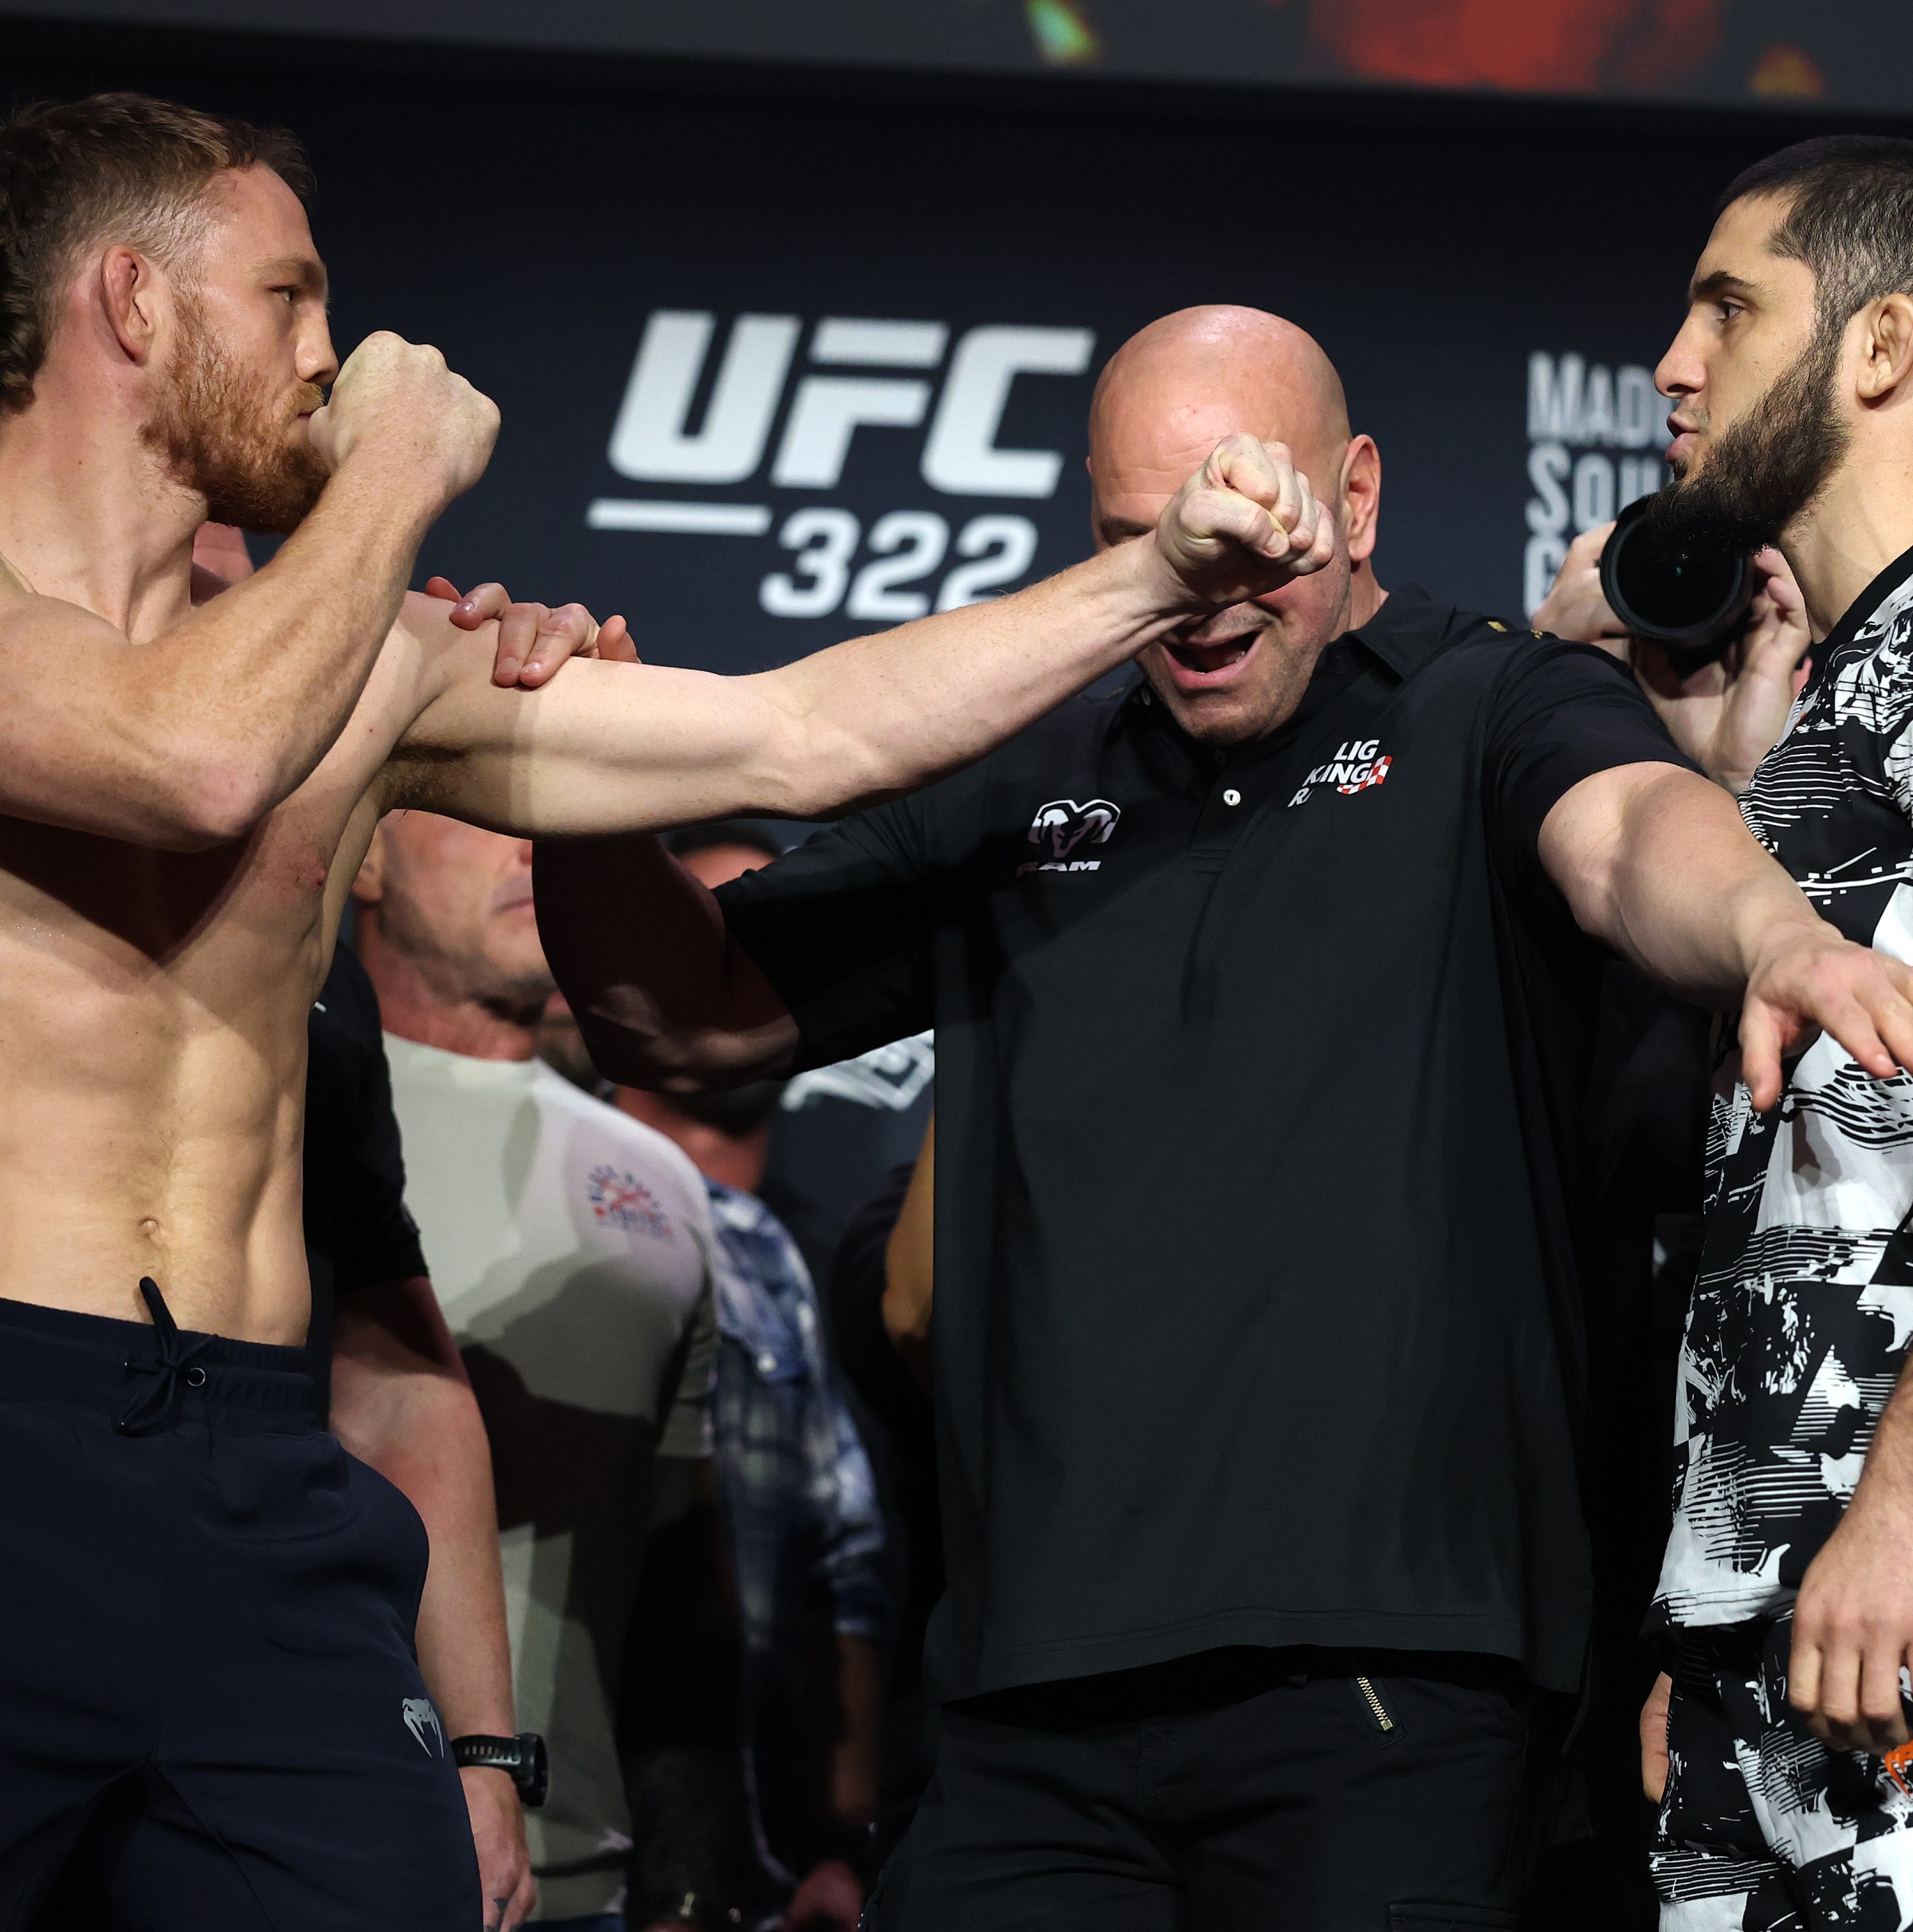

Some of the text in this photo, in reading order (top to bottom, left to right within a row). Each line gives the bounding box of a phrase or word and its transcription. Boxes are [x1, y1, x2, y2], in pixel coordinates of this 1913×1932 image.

[607, 309, 1097, 498] UFC
[758, 507, 1038, 621] 322
[1333, 739, 1381, 761] LIG
[1302, 762, 1373, 787] KING
[1015, 861, 1102, 878] RAM
